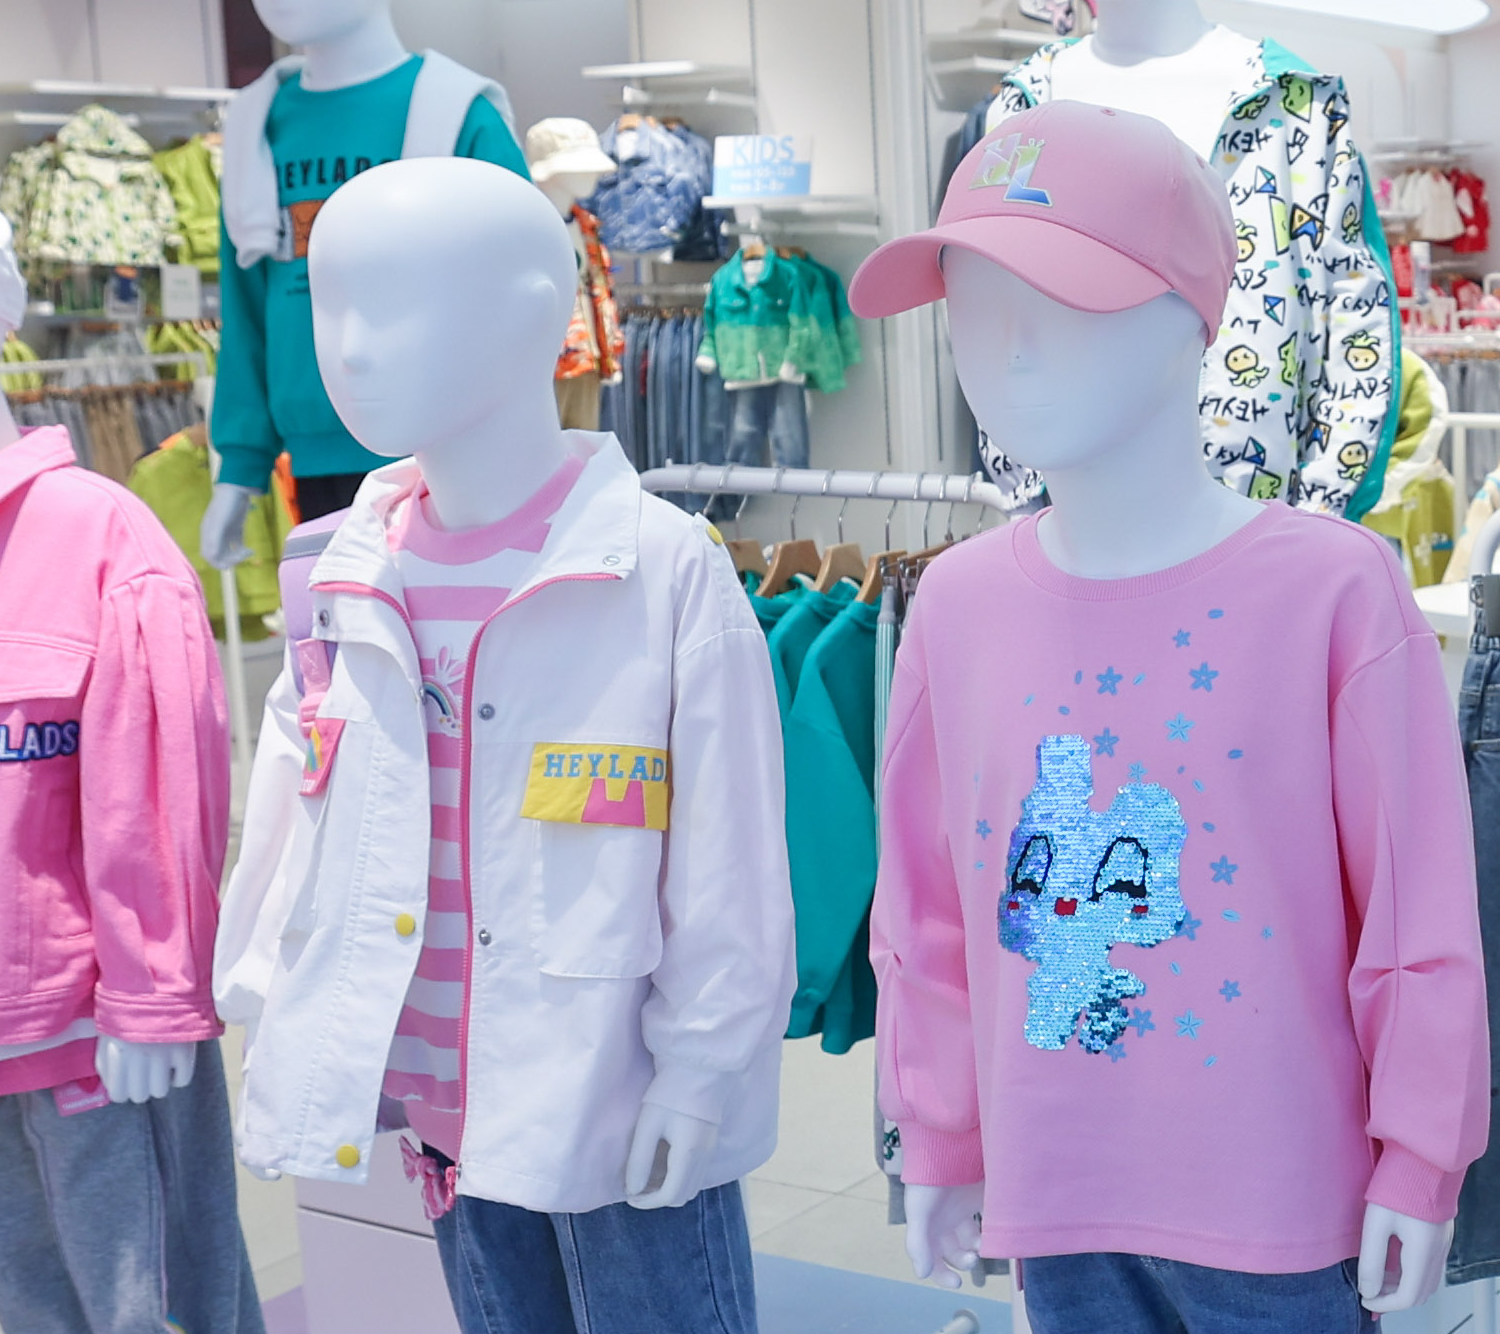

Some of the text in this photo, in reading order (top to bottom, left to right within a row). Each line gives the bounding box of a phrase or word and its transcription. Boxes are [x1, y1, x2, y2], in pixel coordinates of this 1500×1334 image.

[733, 136, 795, 165] KIDS
[284, 156, 398, 190] EYLAD
[543, 752, 666, 783] HEYLAD
